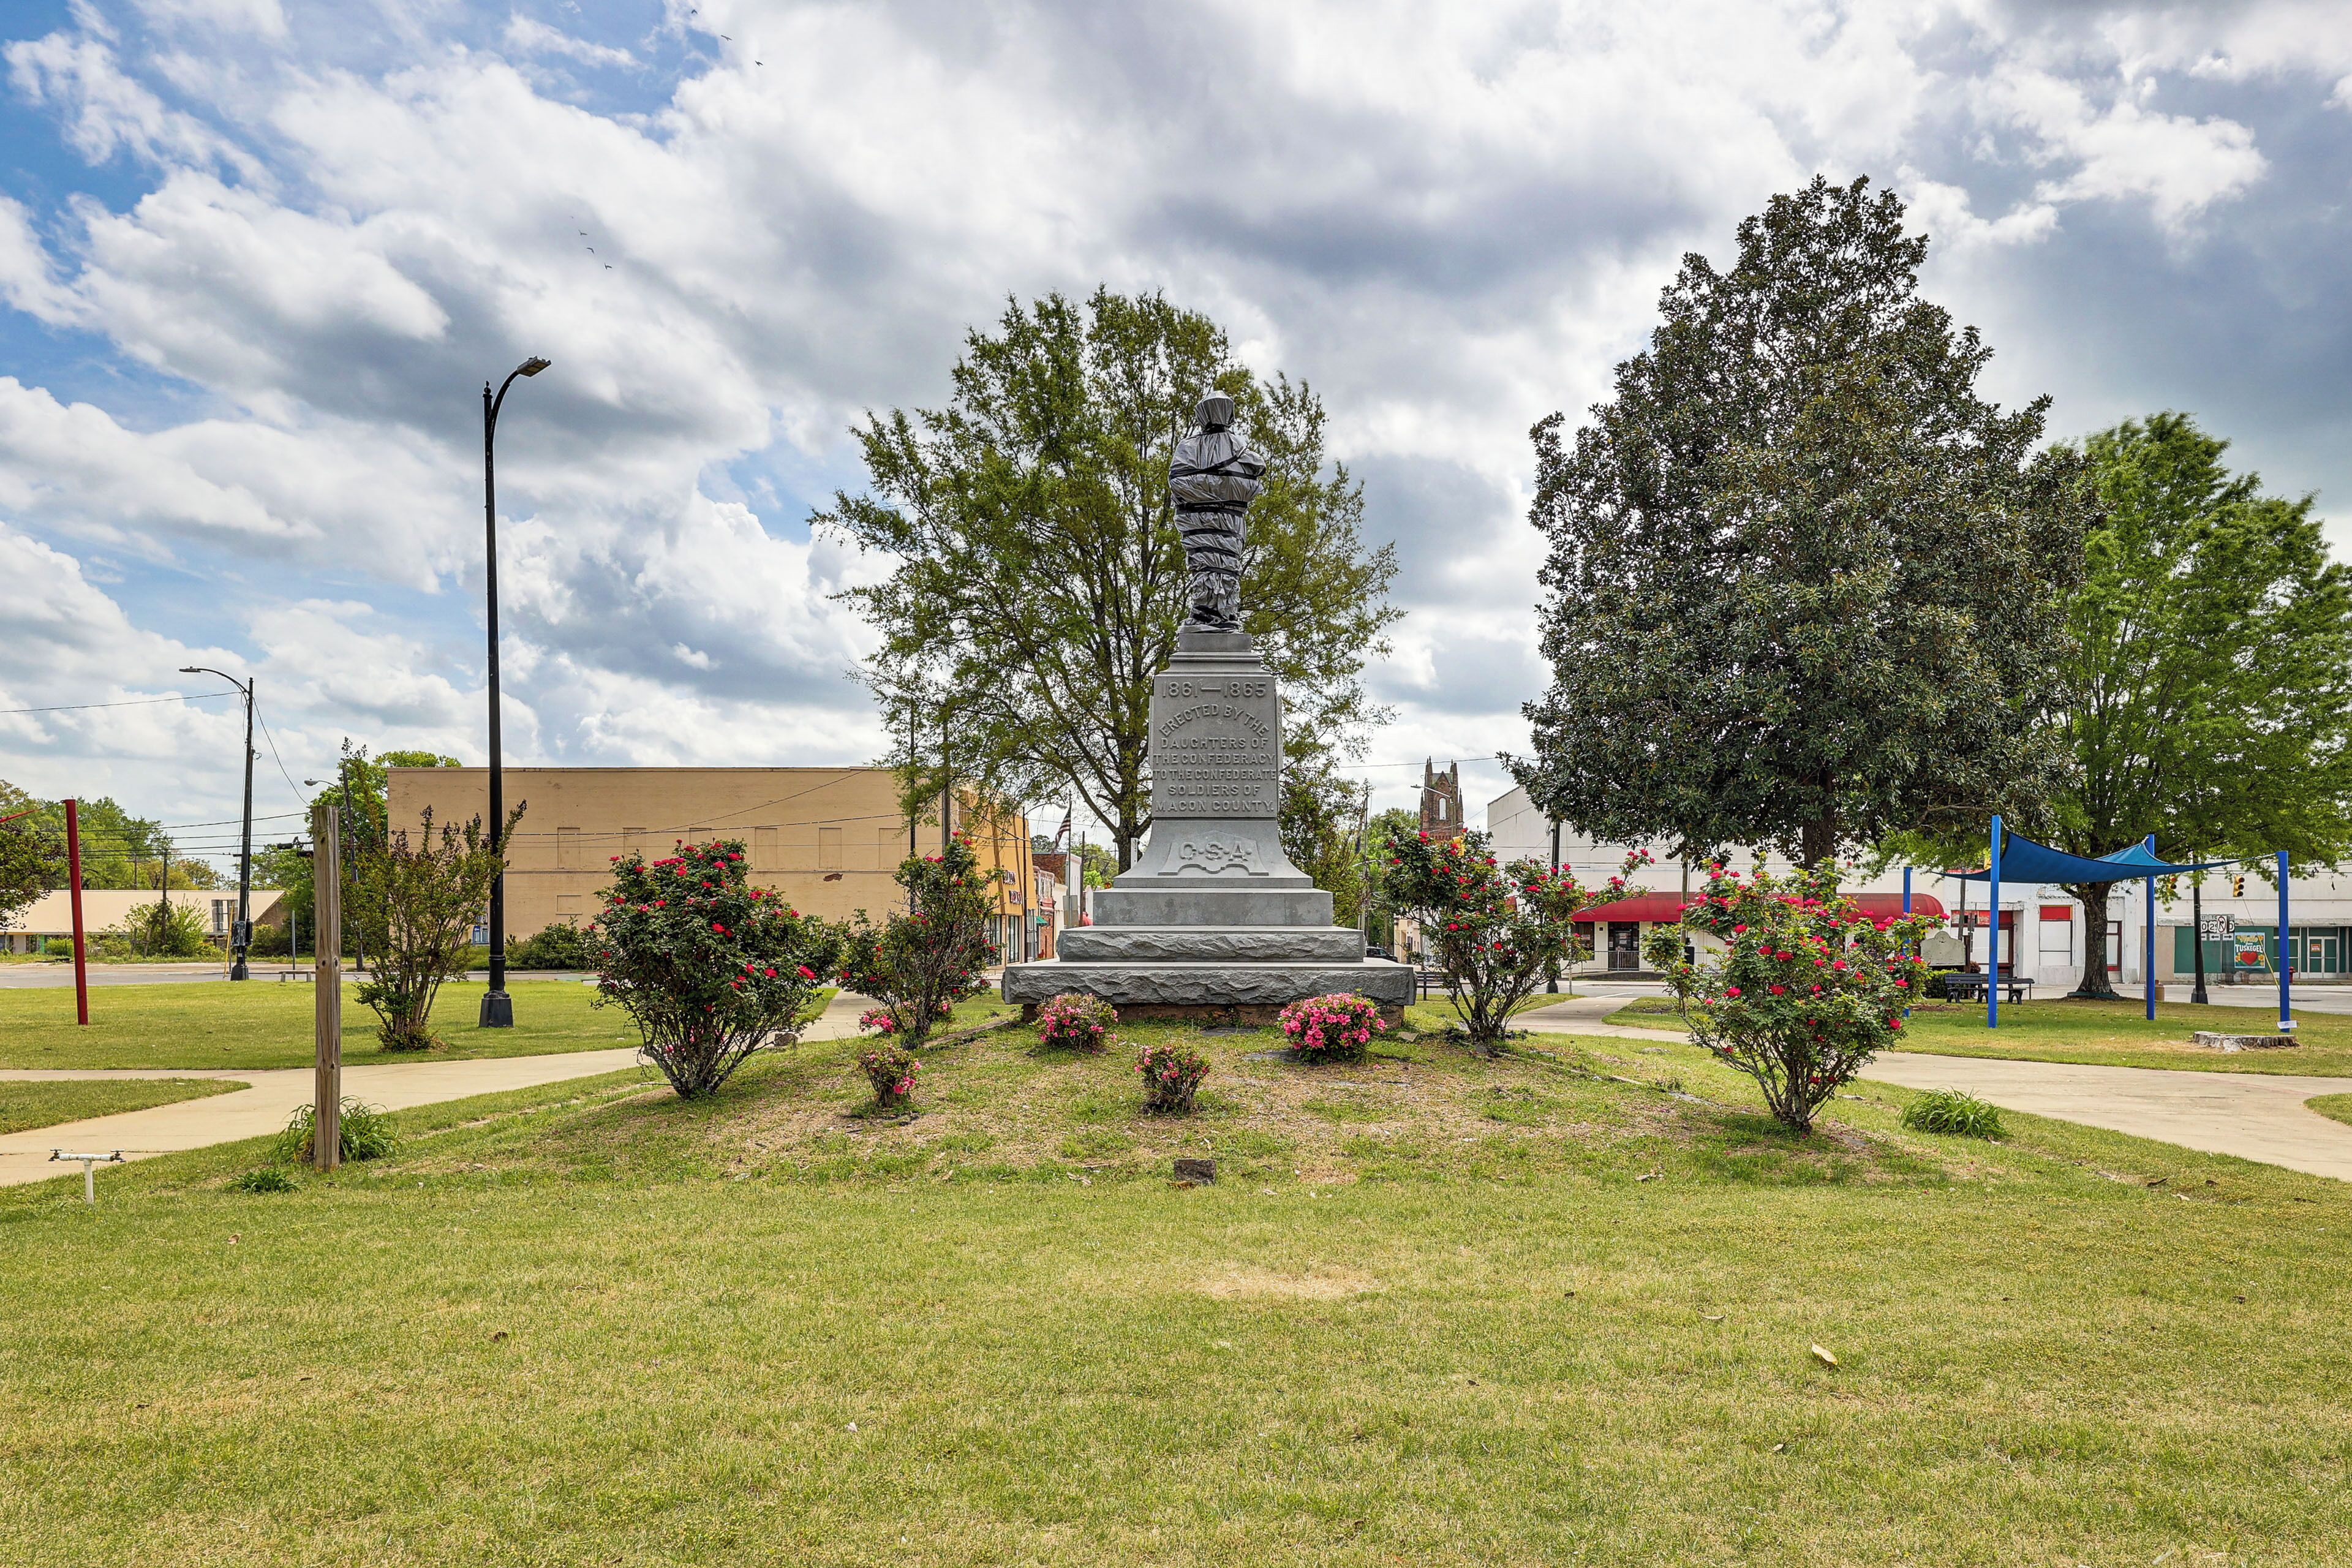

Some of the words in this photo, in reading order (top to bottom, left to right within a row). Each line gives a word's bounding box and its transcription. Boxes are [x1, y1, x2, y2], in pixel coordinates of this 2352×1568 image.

[1159, 704, 1219, 737] ERECTED
[1223, 704, 1245, 720] BY
[1243, 712, 1270, 737] THE
[1161, 737, 1246, 749] DAUGHTERS
[1251, 737, 1268, 749] OF
[1153, 753, 1178, 764] THE
[1182, 753, 1276, 765] CONFEDERACY
[1153, 769, 1167, 780] TO
[1169, 769, 1192, 780] THE
[1195, 769, 1276, 780] CONFEDERATE
[1168, 785, 1239, 796] SOLDIERS
[1243, 785, 1261, 796] OF
[1155, 800, 1207, 812] MACON
[1212, 800, 1275, 812] COUNTY.
[2234, 944, 2263, 953] TUSKEGEE
